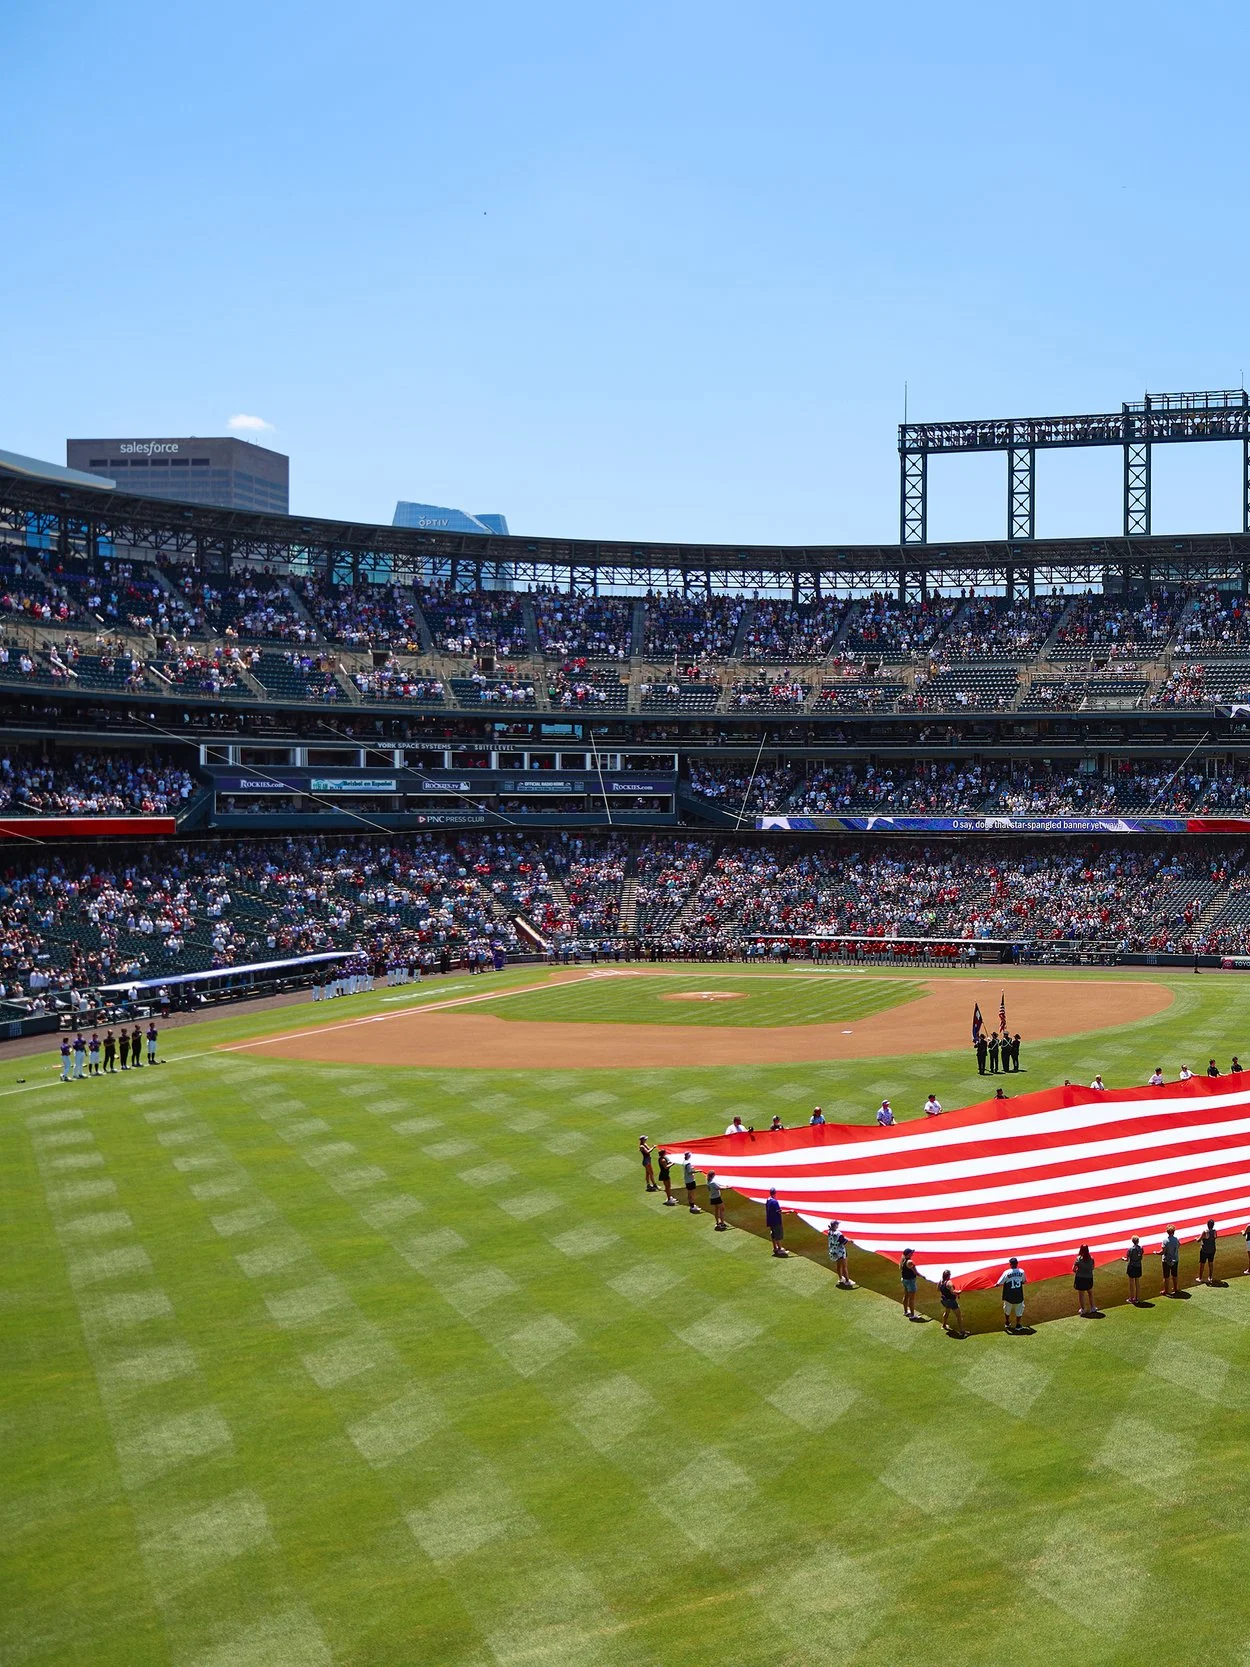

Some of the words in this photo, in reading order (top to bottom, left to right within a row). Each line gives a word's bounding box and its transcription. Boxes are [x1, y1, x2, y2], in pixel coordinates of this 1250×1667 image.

[120, 441, 179, 456] salesforce
[419, 518, 449, 528] OPTIV
[427, 815, 445, 823] PNC
[952, 819, 959, 829] O
[959, 821, 974, 830] say,
[1010, 820, 1062, 831] star-spangled
[1063, 820, 1091, 829] banner
[1090, 821, 1103, 831] yet
[1010, 1279, 1021, 1288] 13
